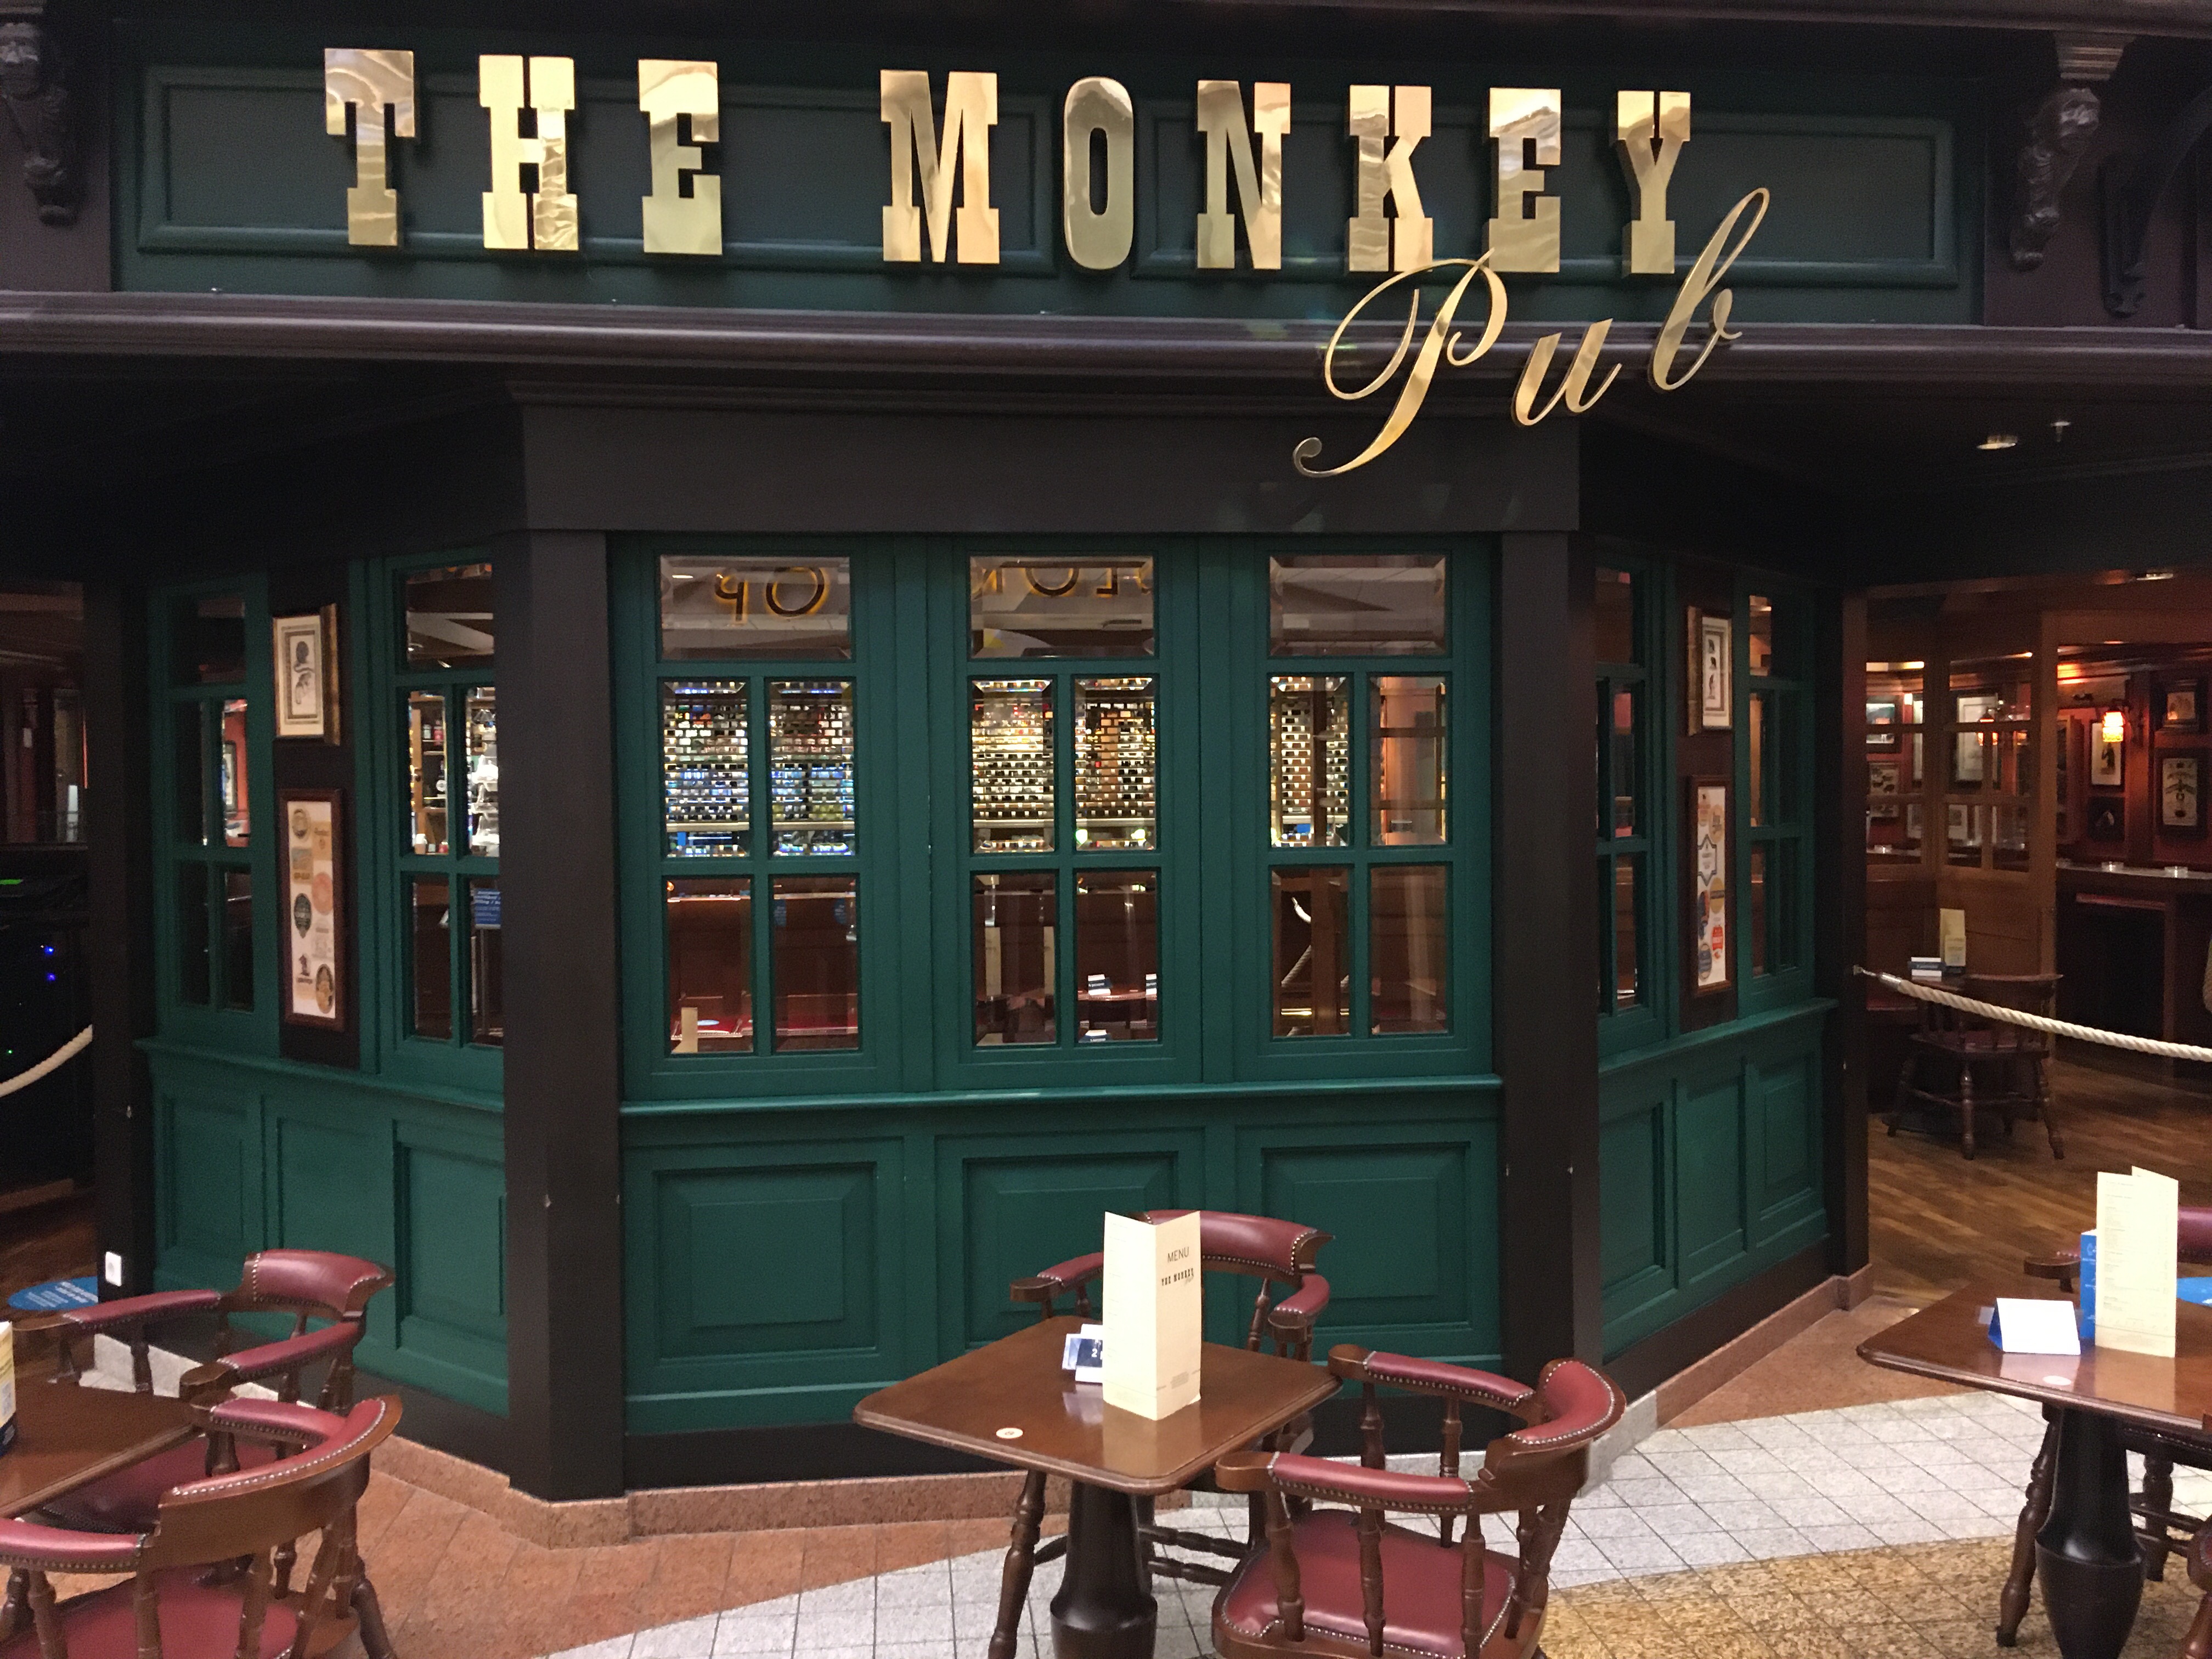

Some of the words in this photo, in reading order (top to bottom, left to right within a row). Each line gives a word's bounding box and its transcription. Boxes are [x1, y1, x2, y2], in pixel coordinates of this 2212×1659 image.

[325, 48, 722, 255] THE
[880, 70, 1691, 274] MONKEY
[1293, 187, 1770, 478] Pub
[1167, 1246, 1189, 1263] MENU
